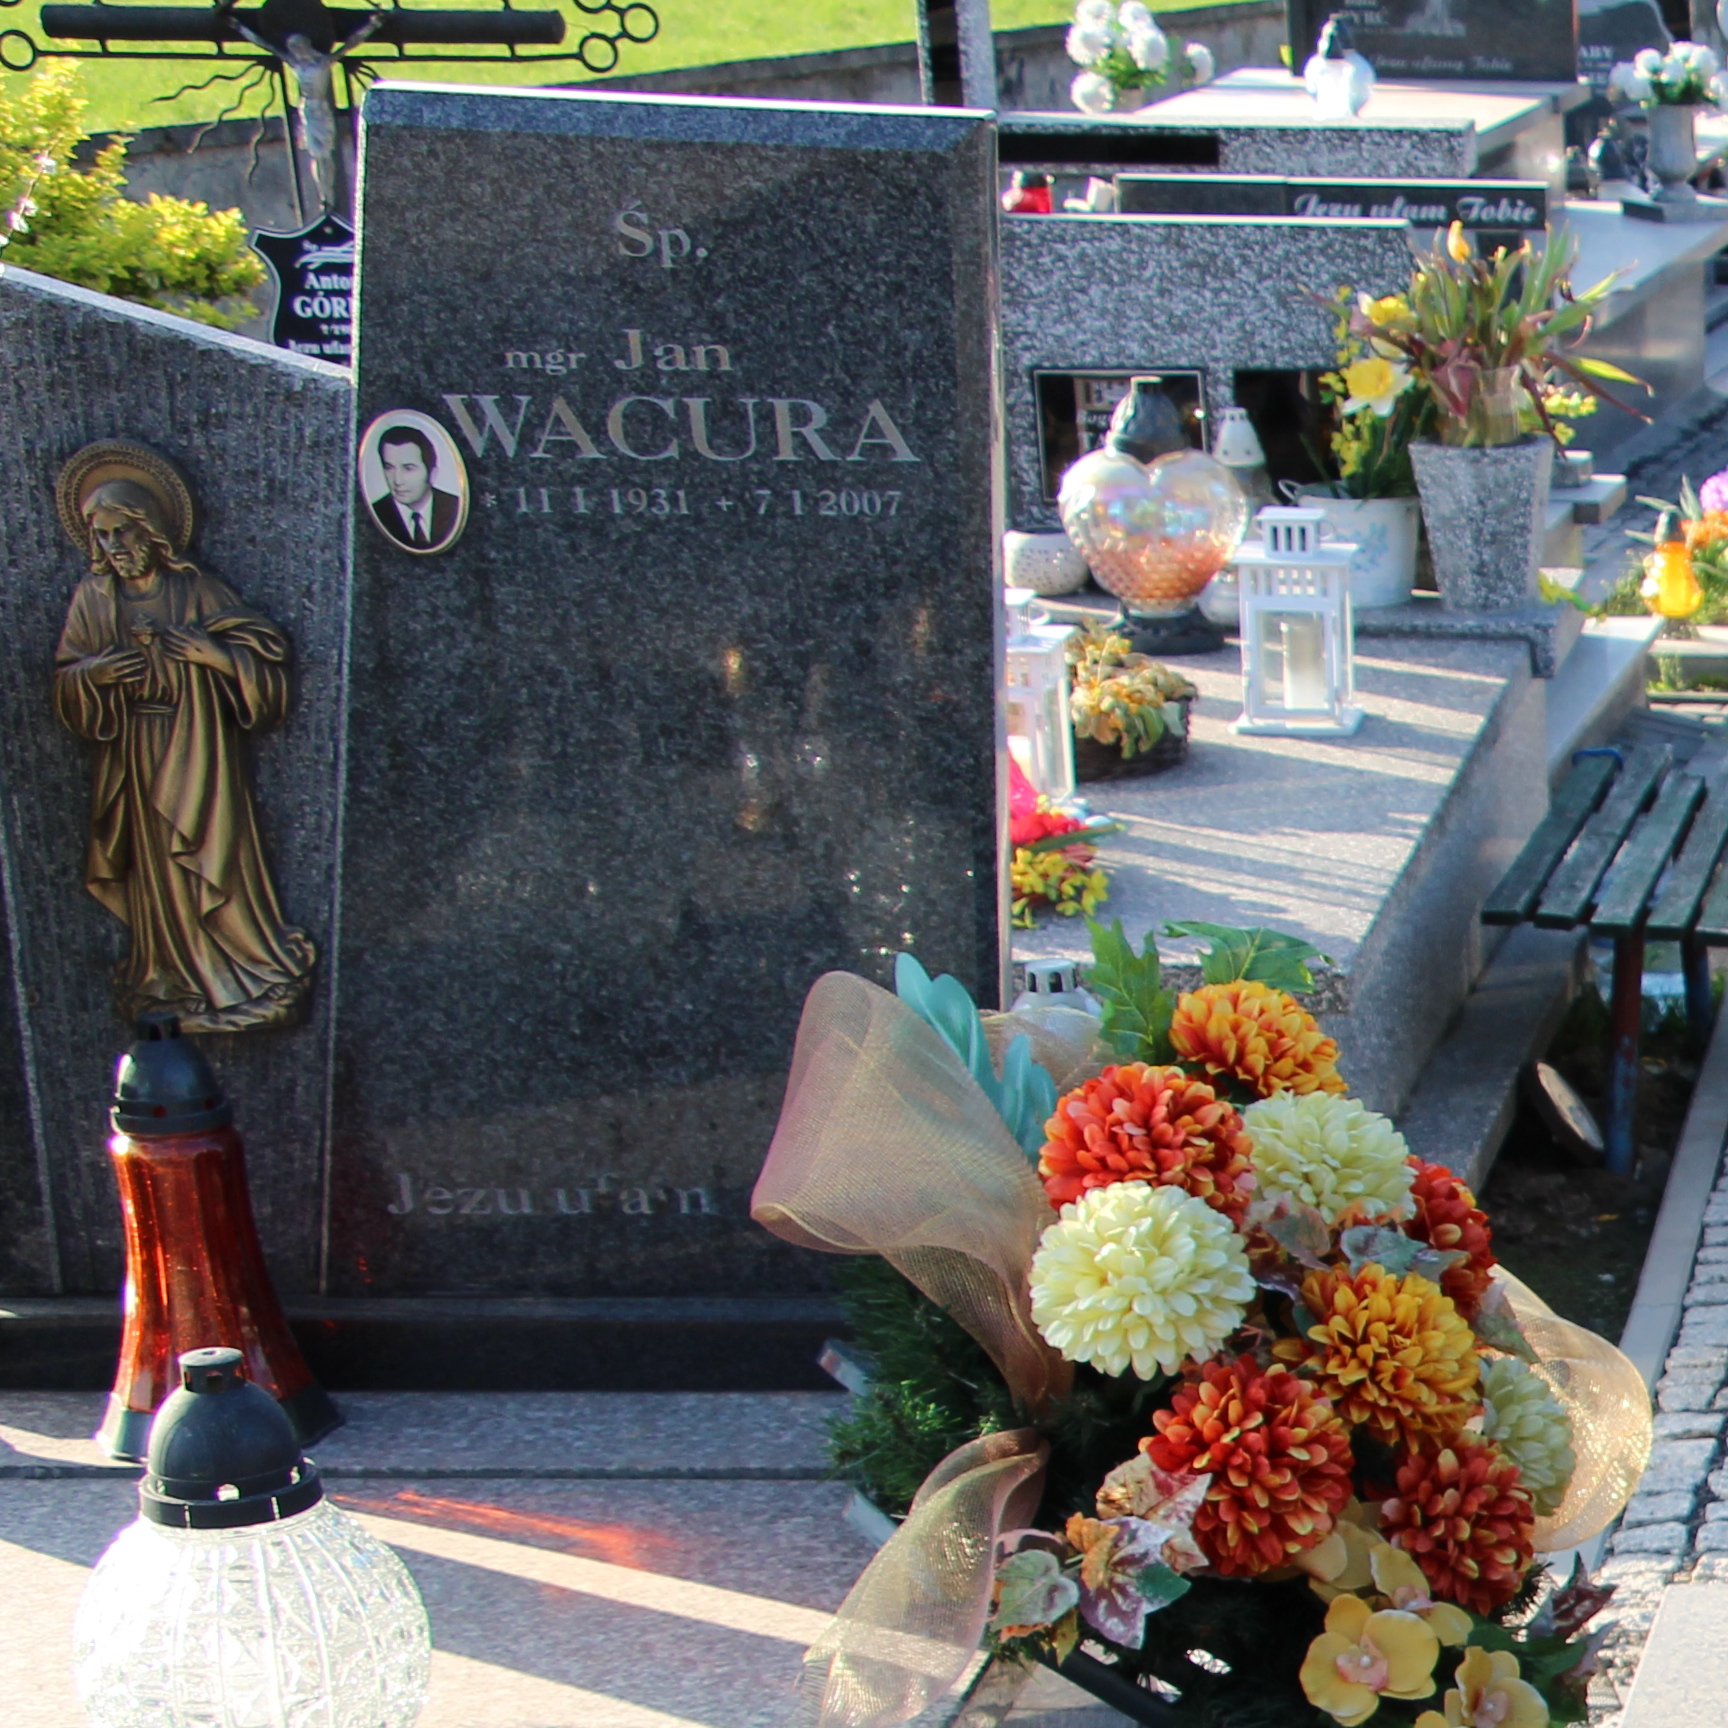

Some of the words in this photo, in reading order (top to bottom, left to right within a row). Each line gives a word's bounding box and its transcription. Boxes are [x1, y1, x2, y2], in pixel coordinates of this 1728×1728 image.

[1294, 192, 1364, 217] Jezu
[1370, 195, 1449, 221] ufam
[1456, 196, 1537, 223] Tobie
[617, 201, 709, 268] Śp.
[504, 348, 587, 376] mgr
[614, 328, 734, 372] Jan
[441, 393, 922, 462] WACURA
[609, 487, 690, 516] 1931
[754, 489, 772, 516] 7
[816, 488, 902, 517] 2007
[386, 1171, 534, 1216] Jezu
